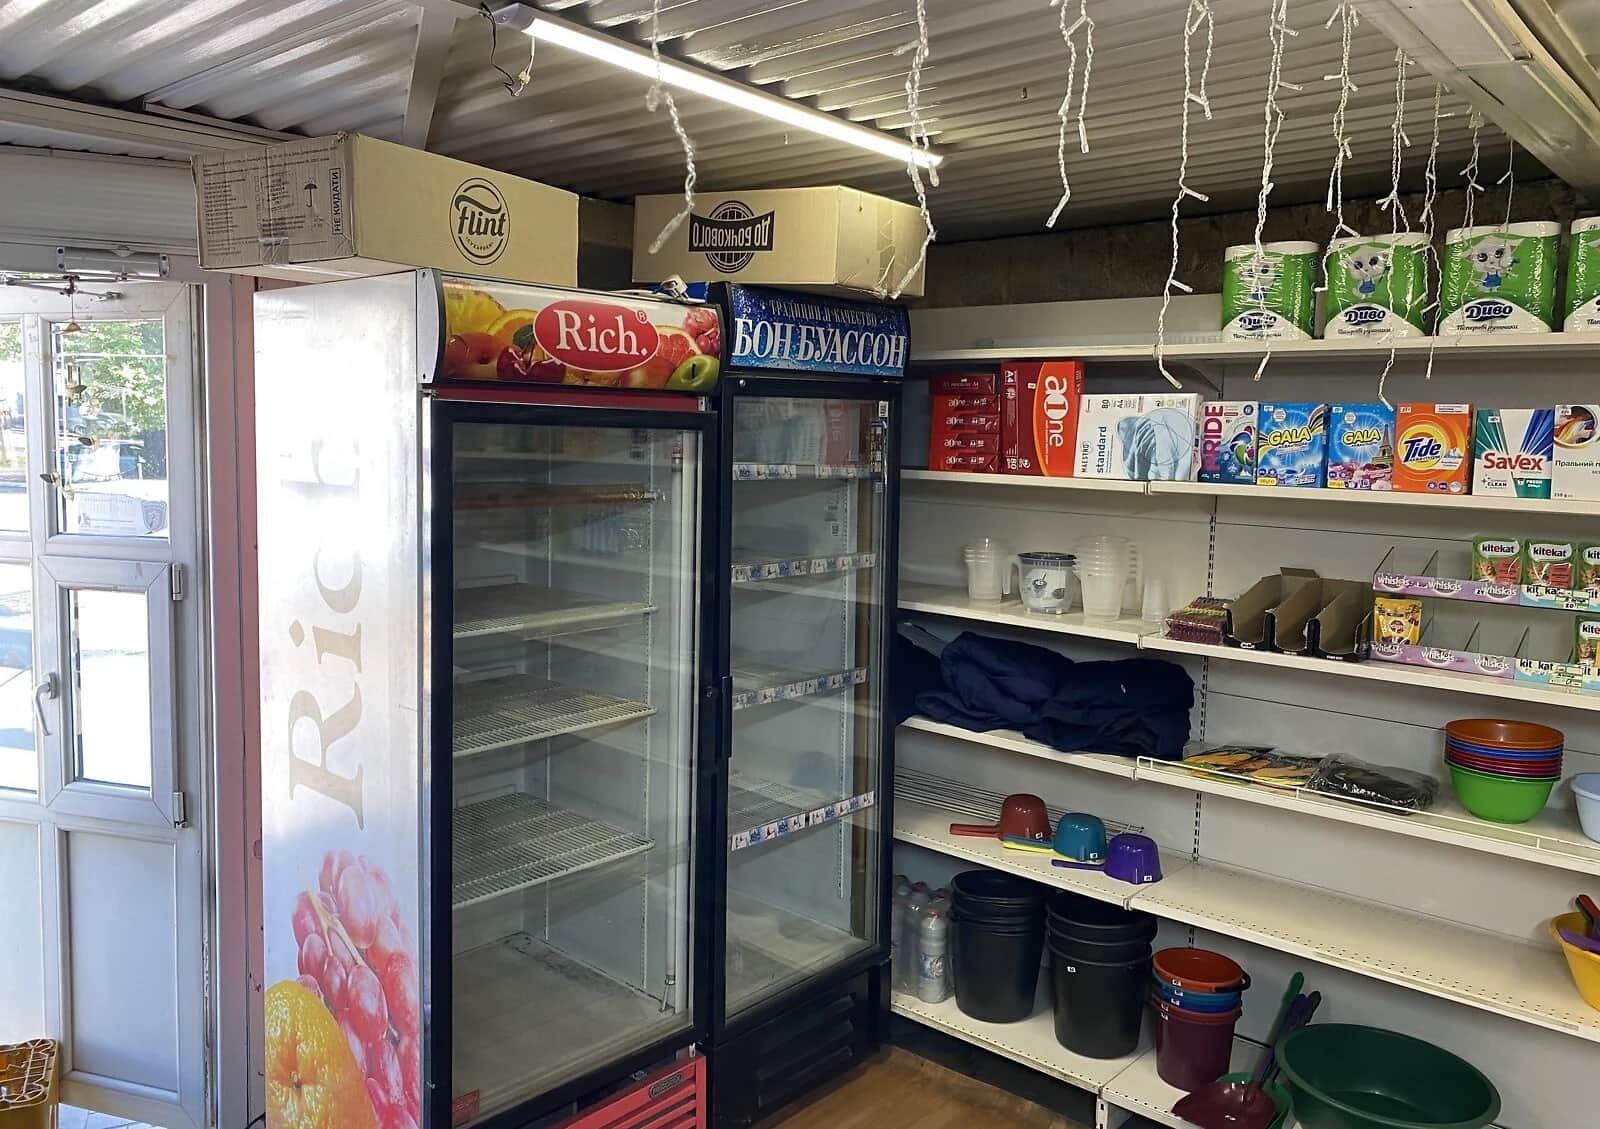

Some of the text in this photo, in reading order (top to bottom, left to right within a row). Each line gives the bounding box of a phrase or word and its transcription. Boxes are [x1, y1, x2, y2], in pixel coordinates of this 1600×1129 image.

[331, 171, 341, 232] НЕ КИДАТИ
[692, 215, 771, 248] ДО БОЧКОВОГО
[1343, 309, 1387, 325] Диво
[1464, 303, 1513, 321] Диво
[732, 317, 907, 369] БОН БУАССОН
[1268, 427, 1312, 447] GALA
[1342, 427, 1381, 446] GALA
[1095, 426, 1107, 474] standard
[1403, 437, 1442, 463] Tide
[1483, 452, 1544, 471] Savex
[1554, 459, 1594, 468] Пральний
[1481, 544, 1515, 554] kitekat
[1532, 546, 1568, 558] kitekat
